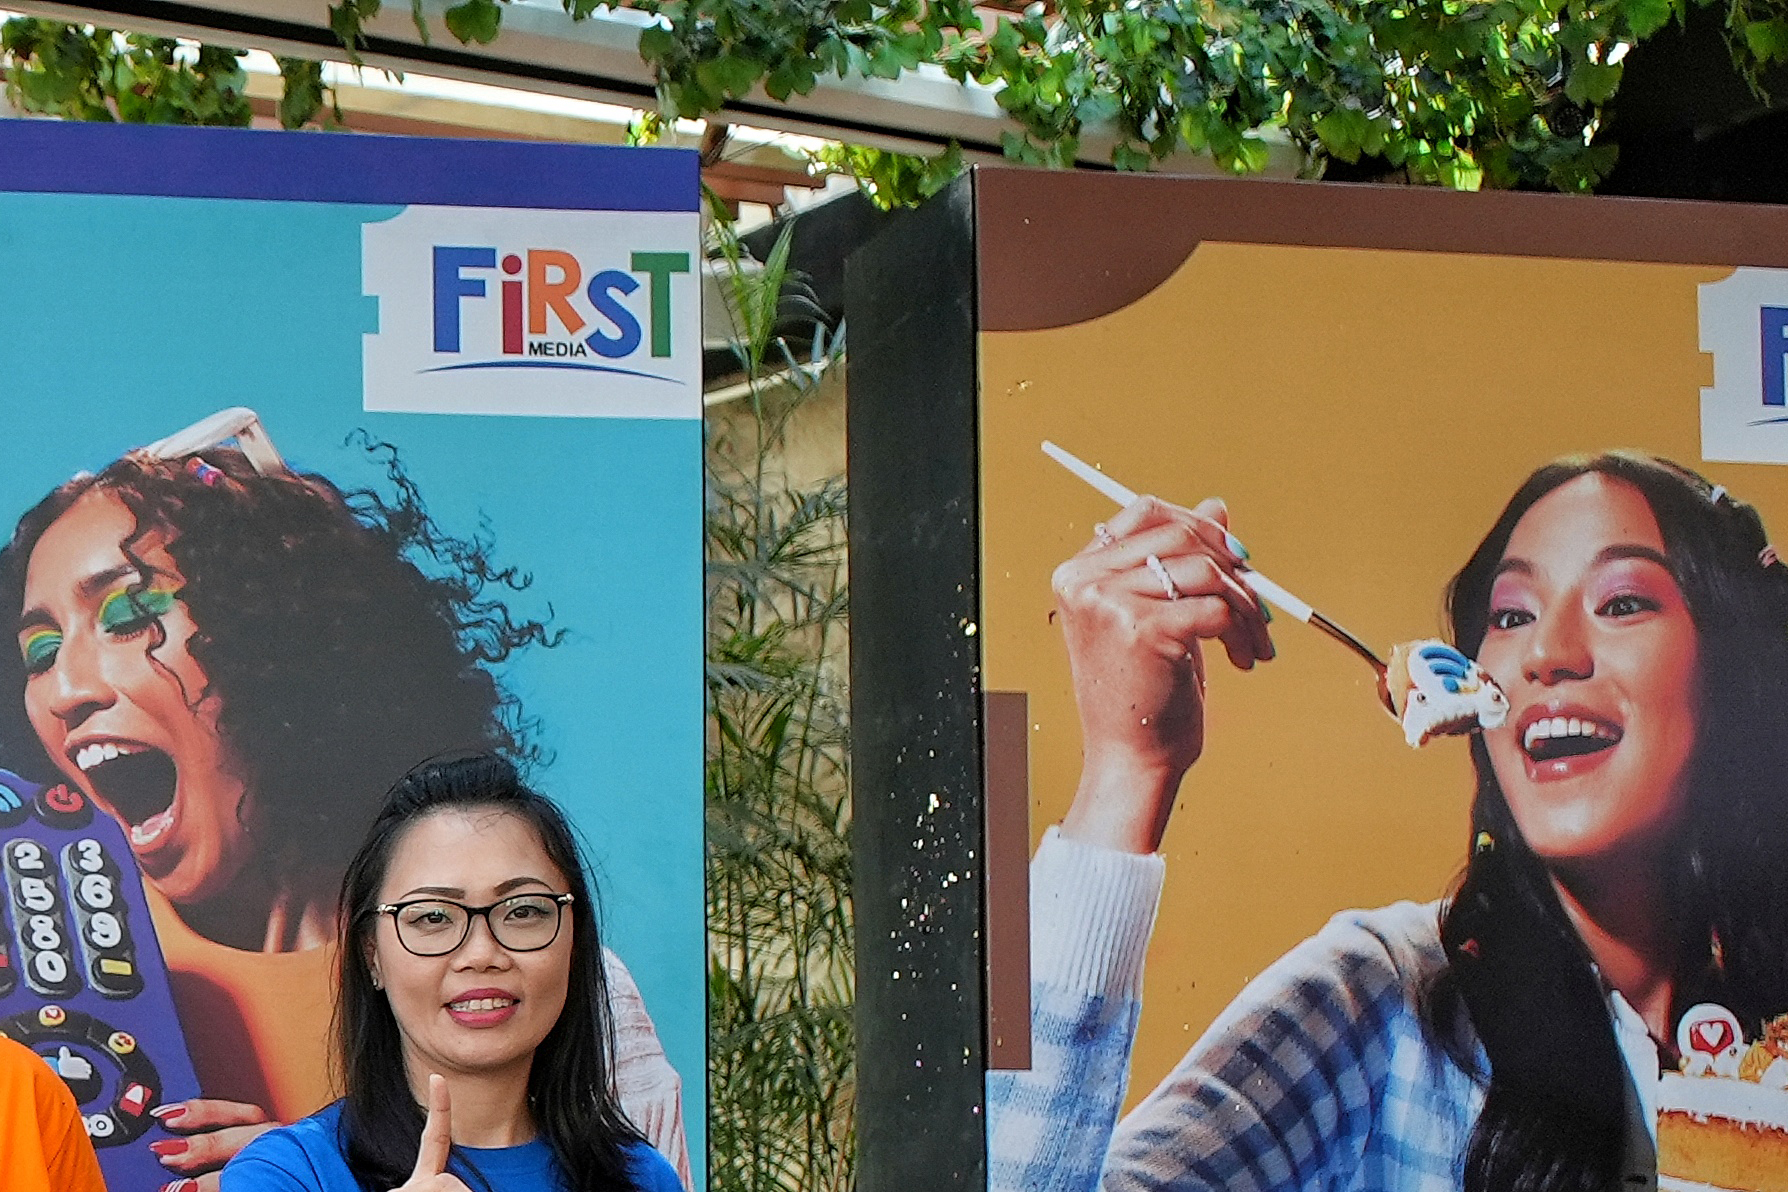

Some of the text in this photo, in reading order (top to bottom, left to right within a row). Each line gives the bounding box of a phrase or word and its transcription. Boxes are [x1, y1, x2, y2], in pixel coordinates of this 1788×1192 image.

[529, 341, 587, 358] MEDIA
[14, 842, 45, 870] 2
[78, 838, 104, 873] 3
[20, 877, 55, 912] 5
[80, 873, 114, 909] 6
[29, 914, 61, 950] 8
[90, 911, 122, 948] 9
